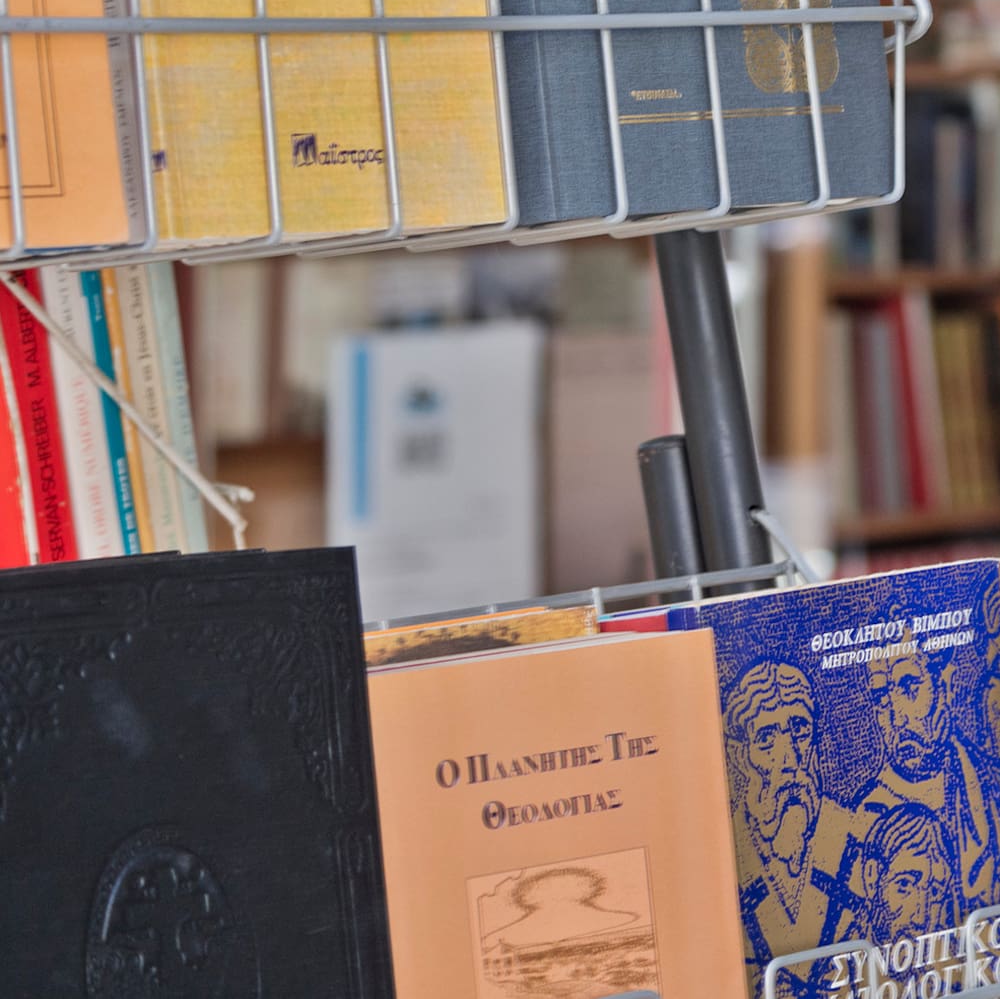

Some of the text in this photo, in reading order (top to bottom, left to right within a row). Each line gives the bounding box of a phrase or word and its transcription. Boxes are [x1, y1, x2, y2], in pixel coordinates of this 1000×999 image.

[811, 608, 973, 652] ΘΕΟΚΛΗΤΟΥ ΒΙΜΠΟΥ
[821, 629, 976, 670] ΜΗΤΡΟΠΟΛΙΤΟΥ ΑΘΗΝΩΝ
[435, 731, 660, 788] Ο ΠΛΑΝΗΤΗΣ ΤΗΣ
[481, 788, 624, 830] ΘΕΟΛΟΓΙΑΣ
